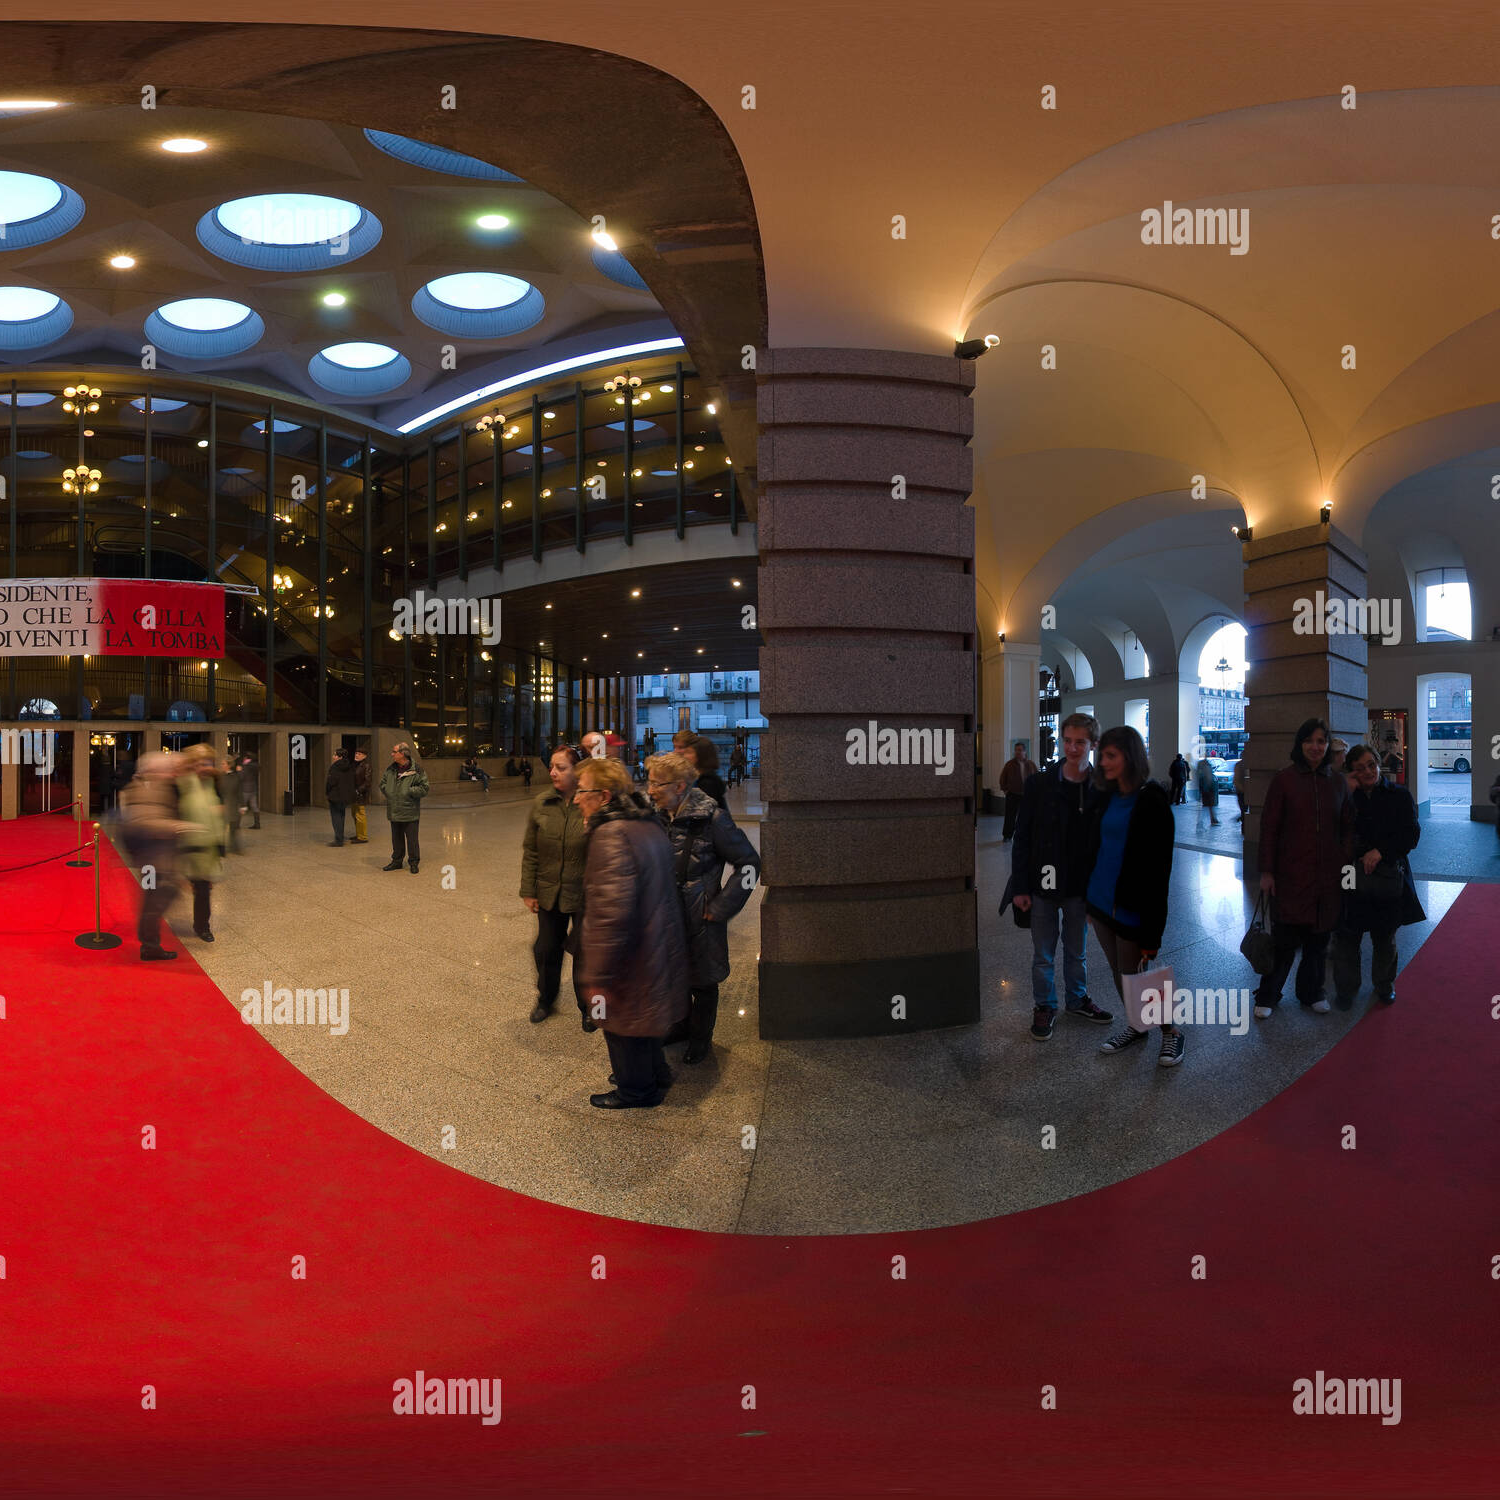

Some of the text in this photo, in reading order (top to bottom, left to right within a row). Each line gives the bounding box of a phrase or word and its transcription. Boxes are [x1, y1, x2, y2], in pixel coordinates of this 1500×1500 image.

[22, 606, 72, 625] CHE
[85, 607, 116, 625] LA
[105, 629, 135, 648] LA
[147, 630, 222, 651] TOMBA
